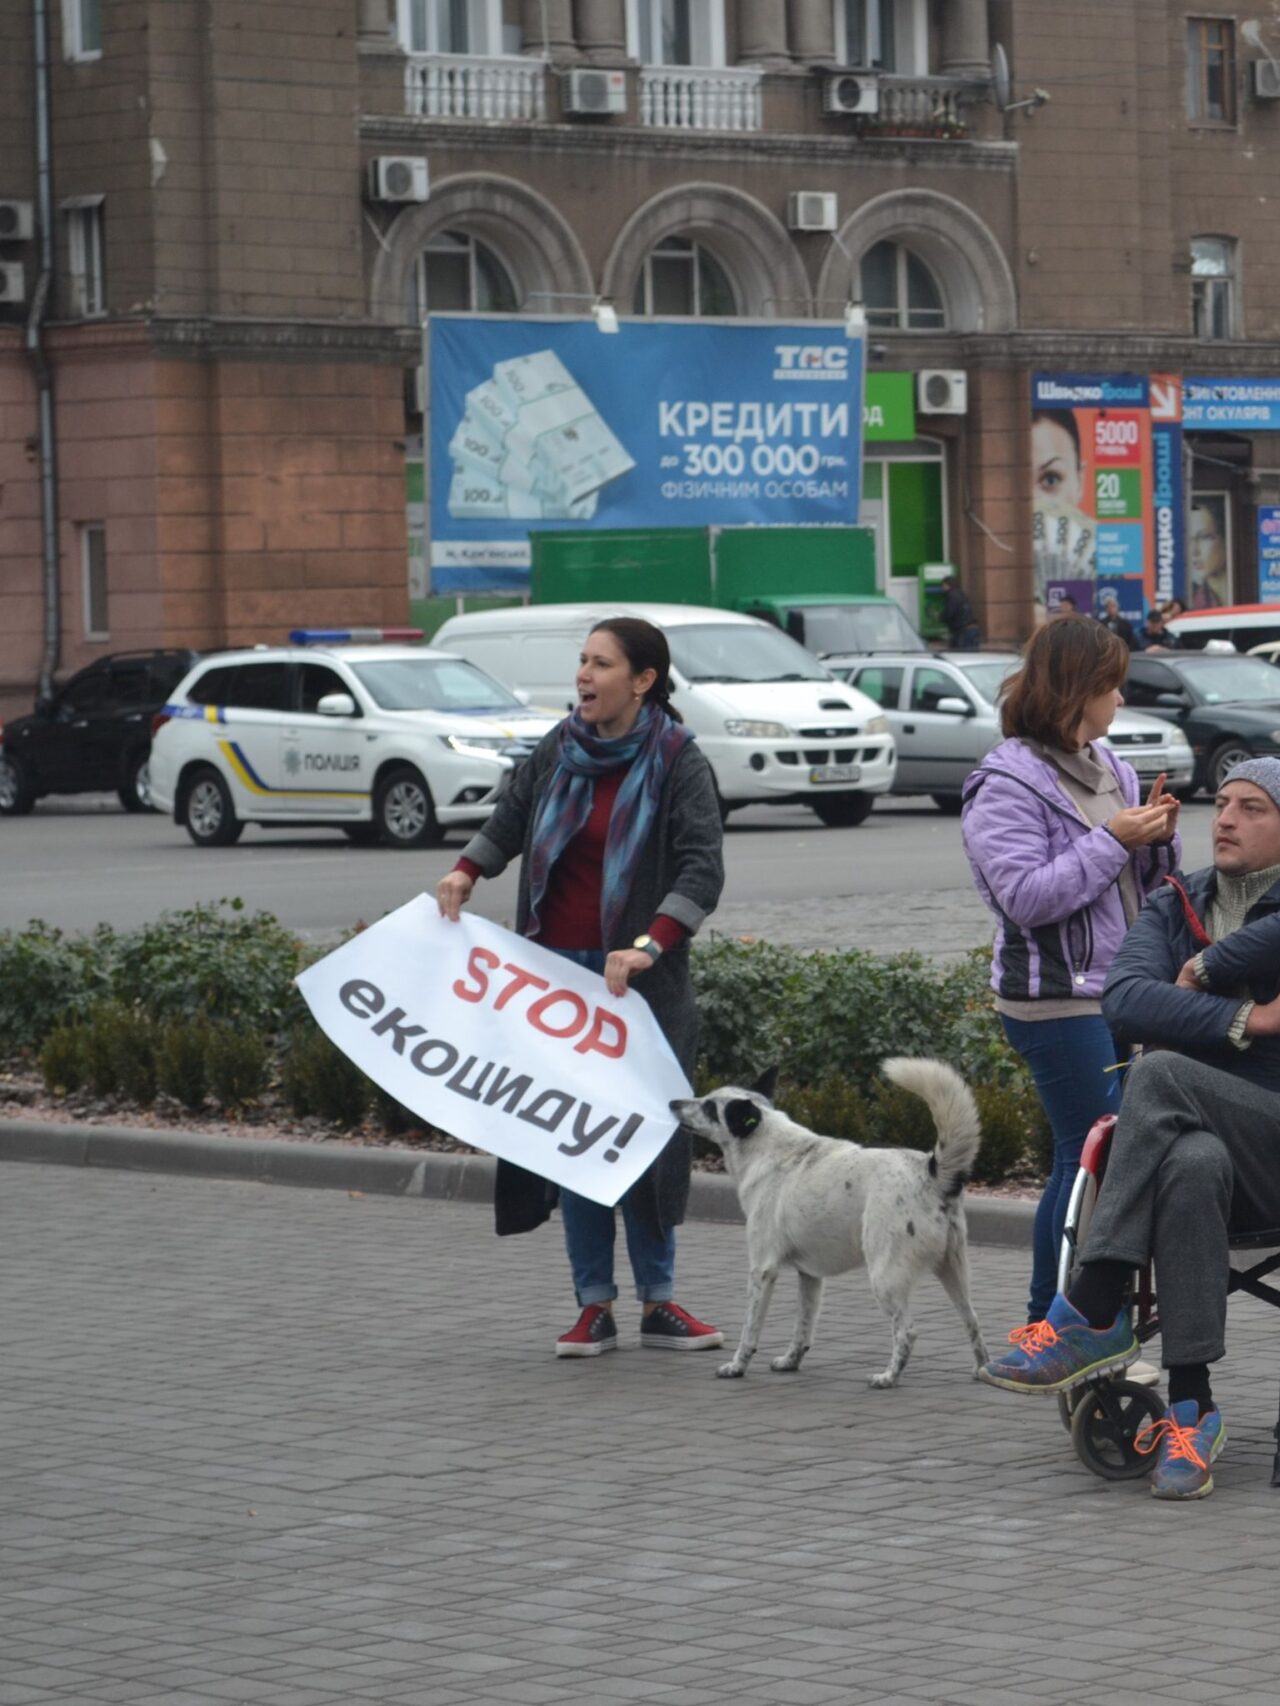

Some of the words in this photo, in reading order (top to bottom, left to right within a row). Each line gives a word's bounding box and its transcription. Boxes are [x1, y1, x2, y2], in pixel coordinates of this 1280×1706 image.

[659, 401, 848, 443] КРЕДИТИ
[1206, 405, 1270, 421] ОКУЛЯРІВ
[1096, 421, 1137, 444] 5000
[660, 456, 679, 469] до
[683, 445, 745, 475] 300
[752, 445, 820, 475] 000
[464, 488, 490, 502] 100
[661, 481, 759, 498] ФІЗИЧНИМ
[765, 481, 848, 498] ОСОБАМ
[1097, 473, 1120, 498] 20
[452, 946, 628, 1059] STOP
[339, 979, 645, 1164] екоциду!
